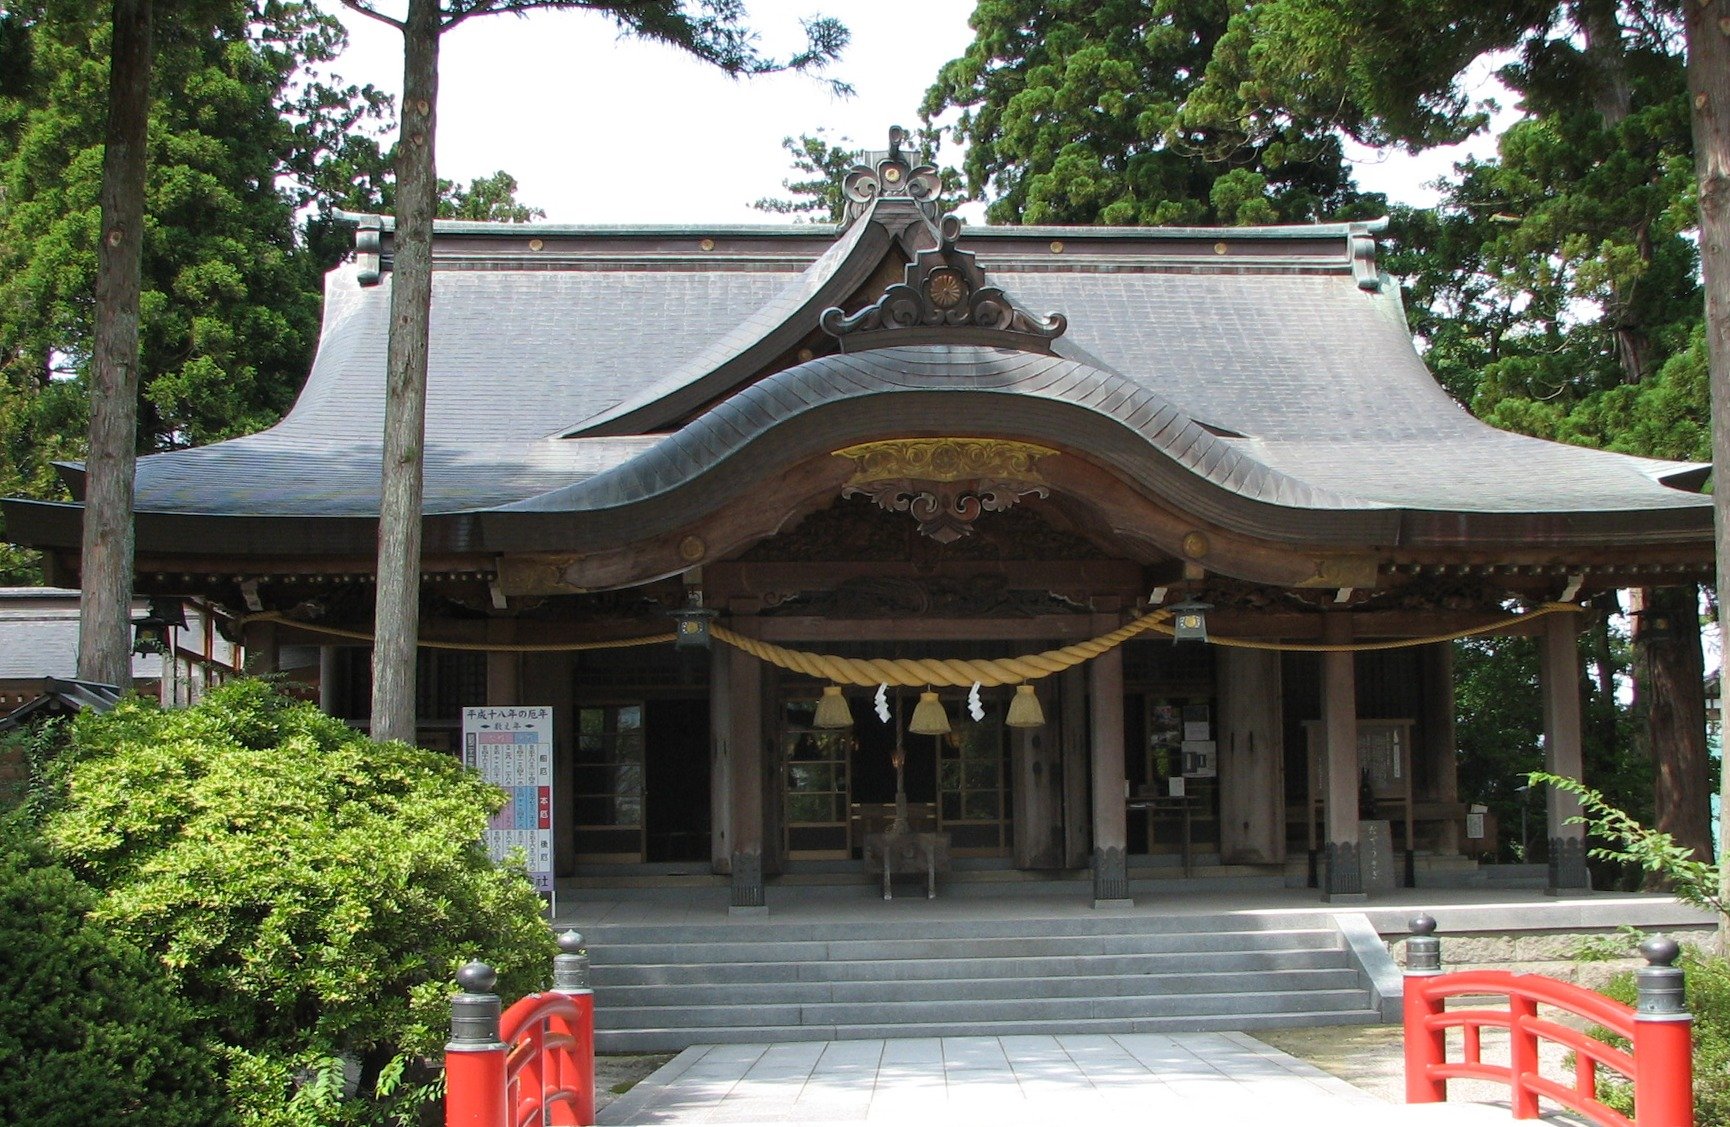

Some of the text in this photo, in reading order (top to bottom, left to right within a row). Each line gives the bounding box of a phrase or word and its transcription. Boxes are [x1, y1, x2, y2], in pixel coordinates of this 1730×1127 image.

[467, 709, 548, 720] 平成十八年の厄年
[539, 797, 549, 819] 本厄
